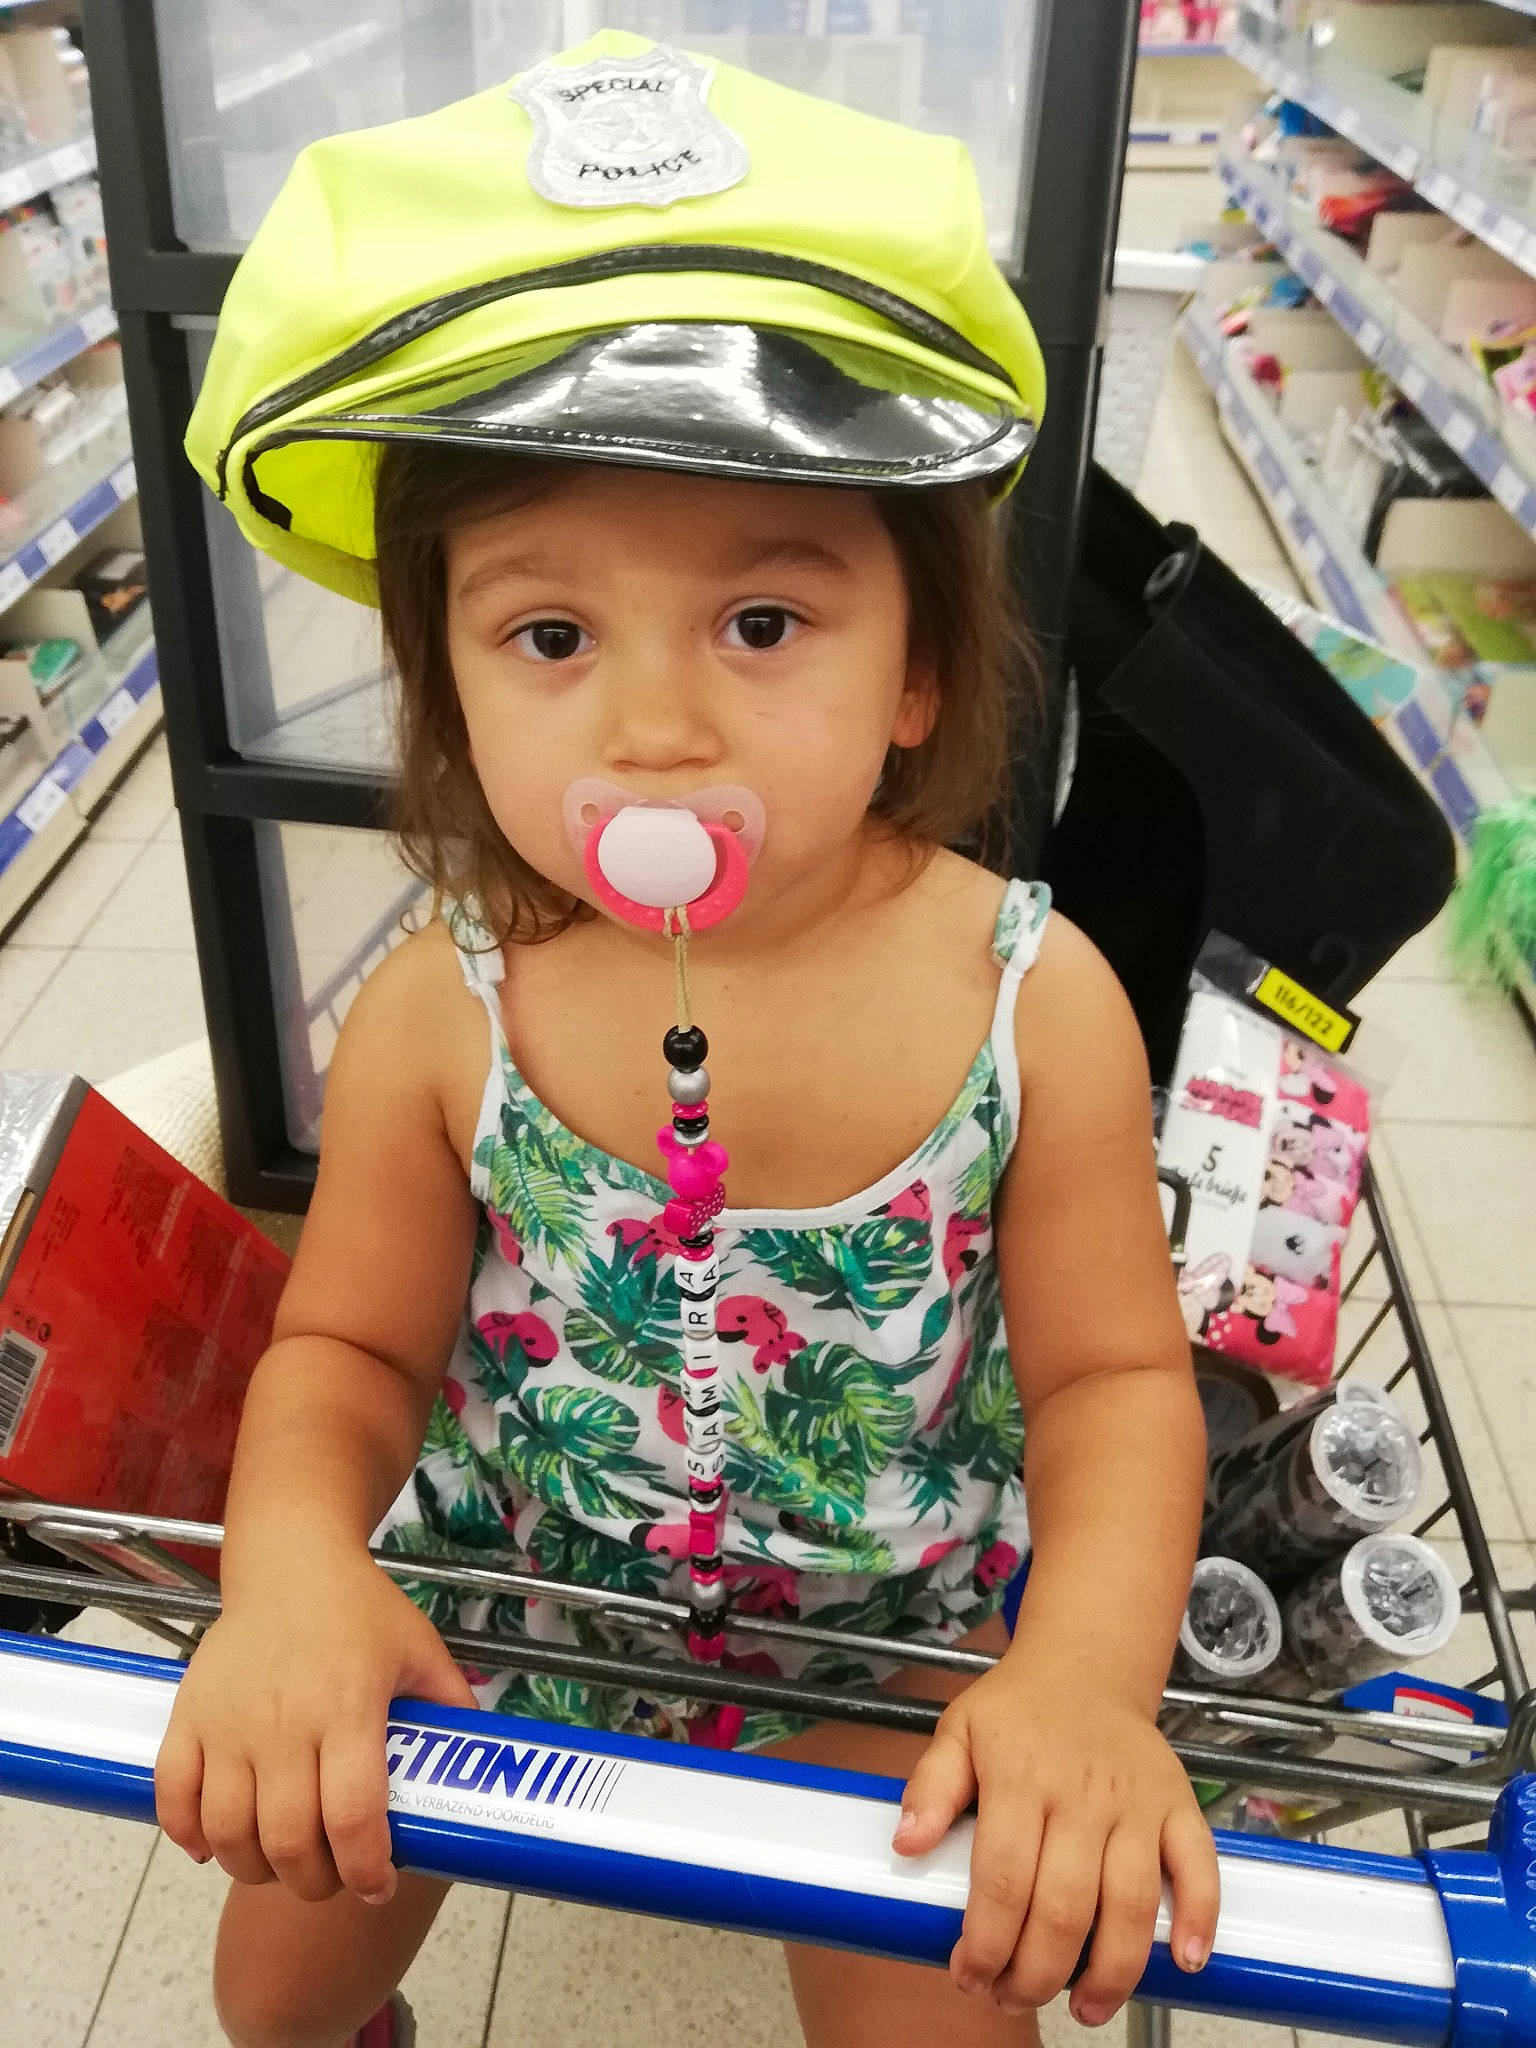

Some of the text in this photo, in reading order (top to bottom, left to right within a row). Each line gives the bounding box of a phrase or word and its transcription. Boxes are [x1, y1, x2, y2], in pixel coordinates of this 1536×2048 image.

[559, 77, 667, 102] SPECIAL
[578, 149, 702, 180] POLICE
[1201, 1145, 1223, 1172] 5
[680, 1263, 725, 1475] SAMIRA
[415, 1793, 483, 1817] VERBAZEND
[486, 1807, 556, 1829] VOORDELIG
